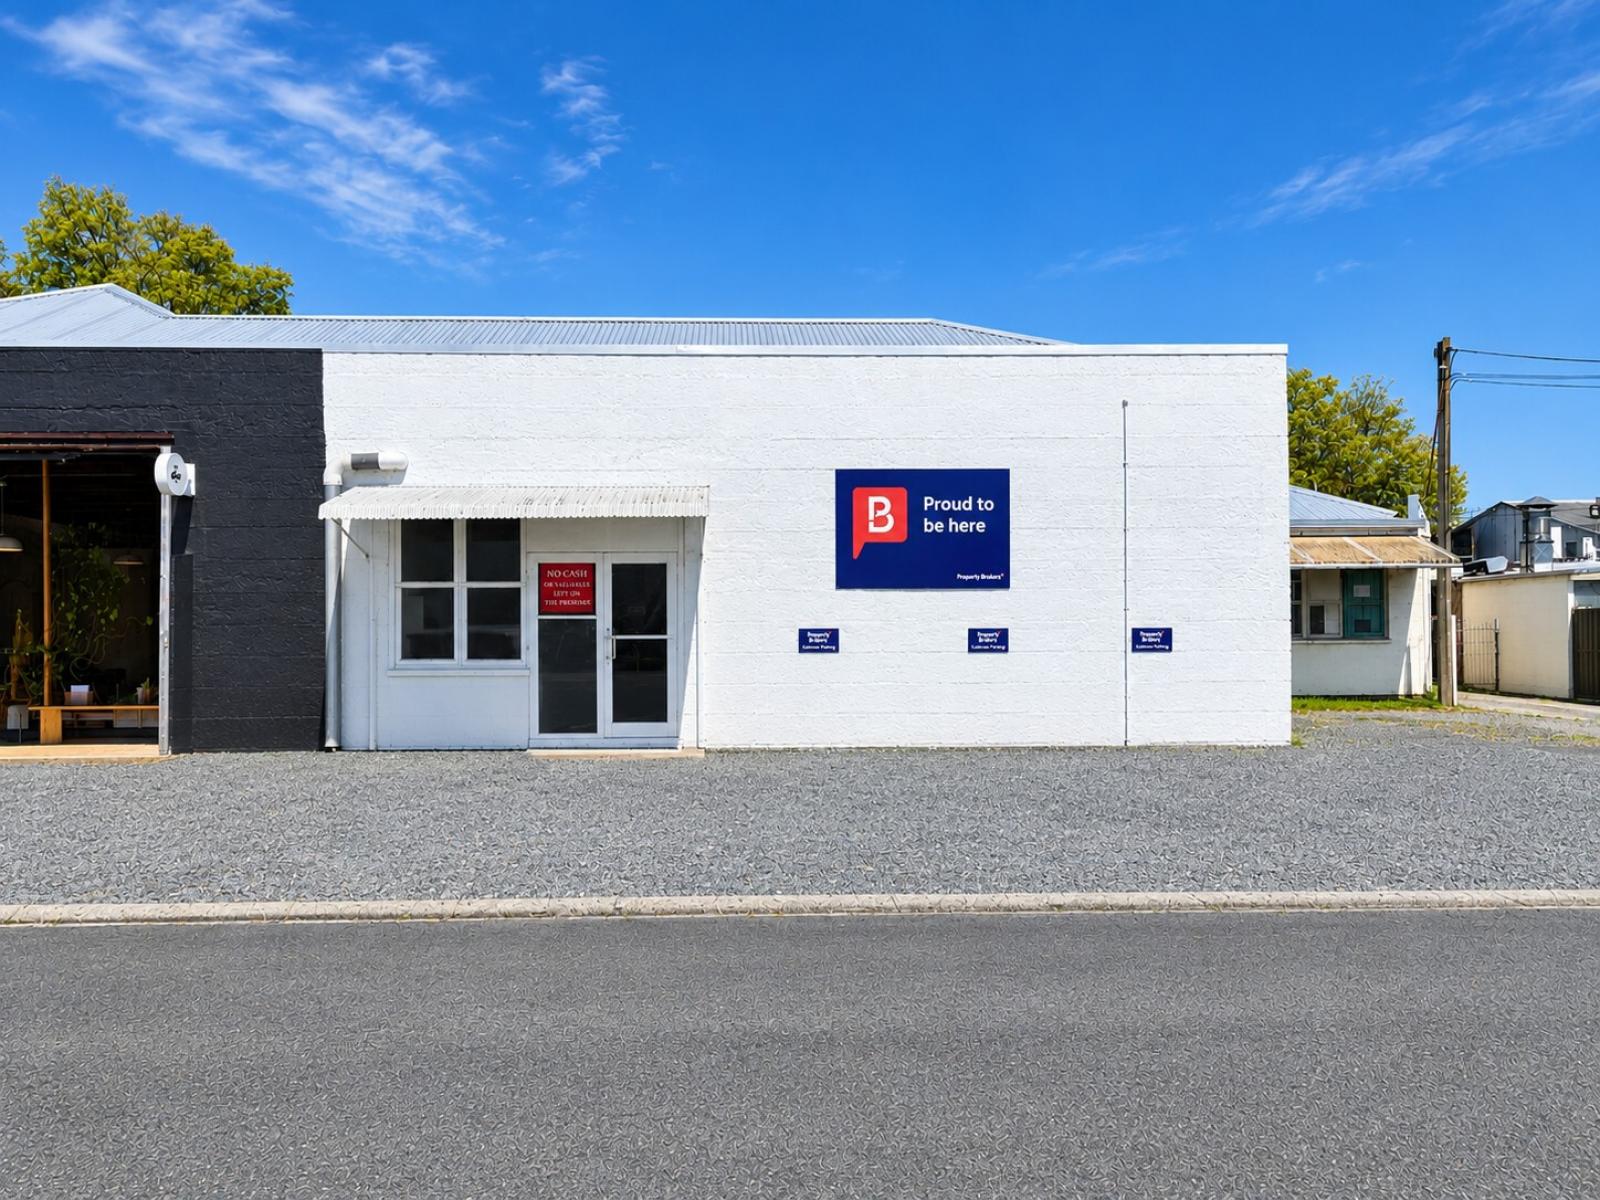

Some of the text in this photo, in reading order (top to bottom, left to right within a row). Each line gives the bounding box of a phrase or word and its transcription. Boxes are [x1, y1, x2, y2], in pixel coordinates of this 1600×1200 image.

[923, 496, 994, 511] Proud to
[868, 495, 895, 533] B
[923, 517, 986, 533] be here
[547, 569, 588, 578] NO CASH
